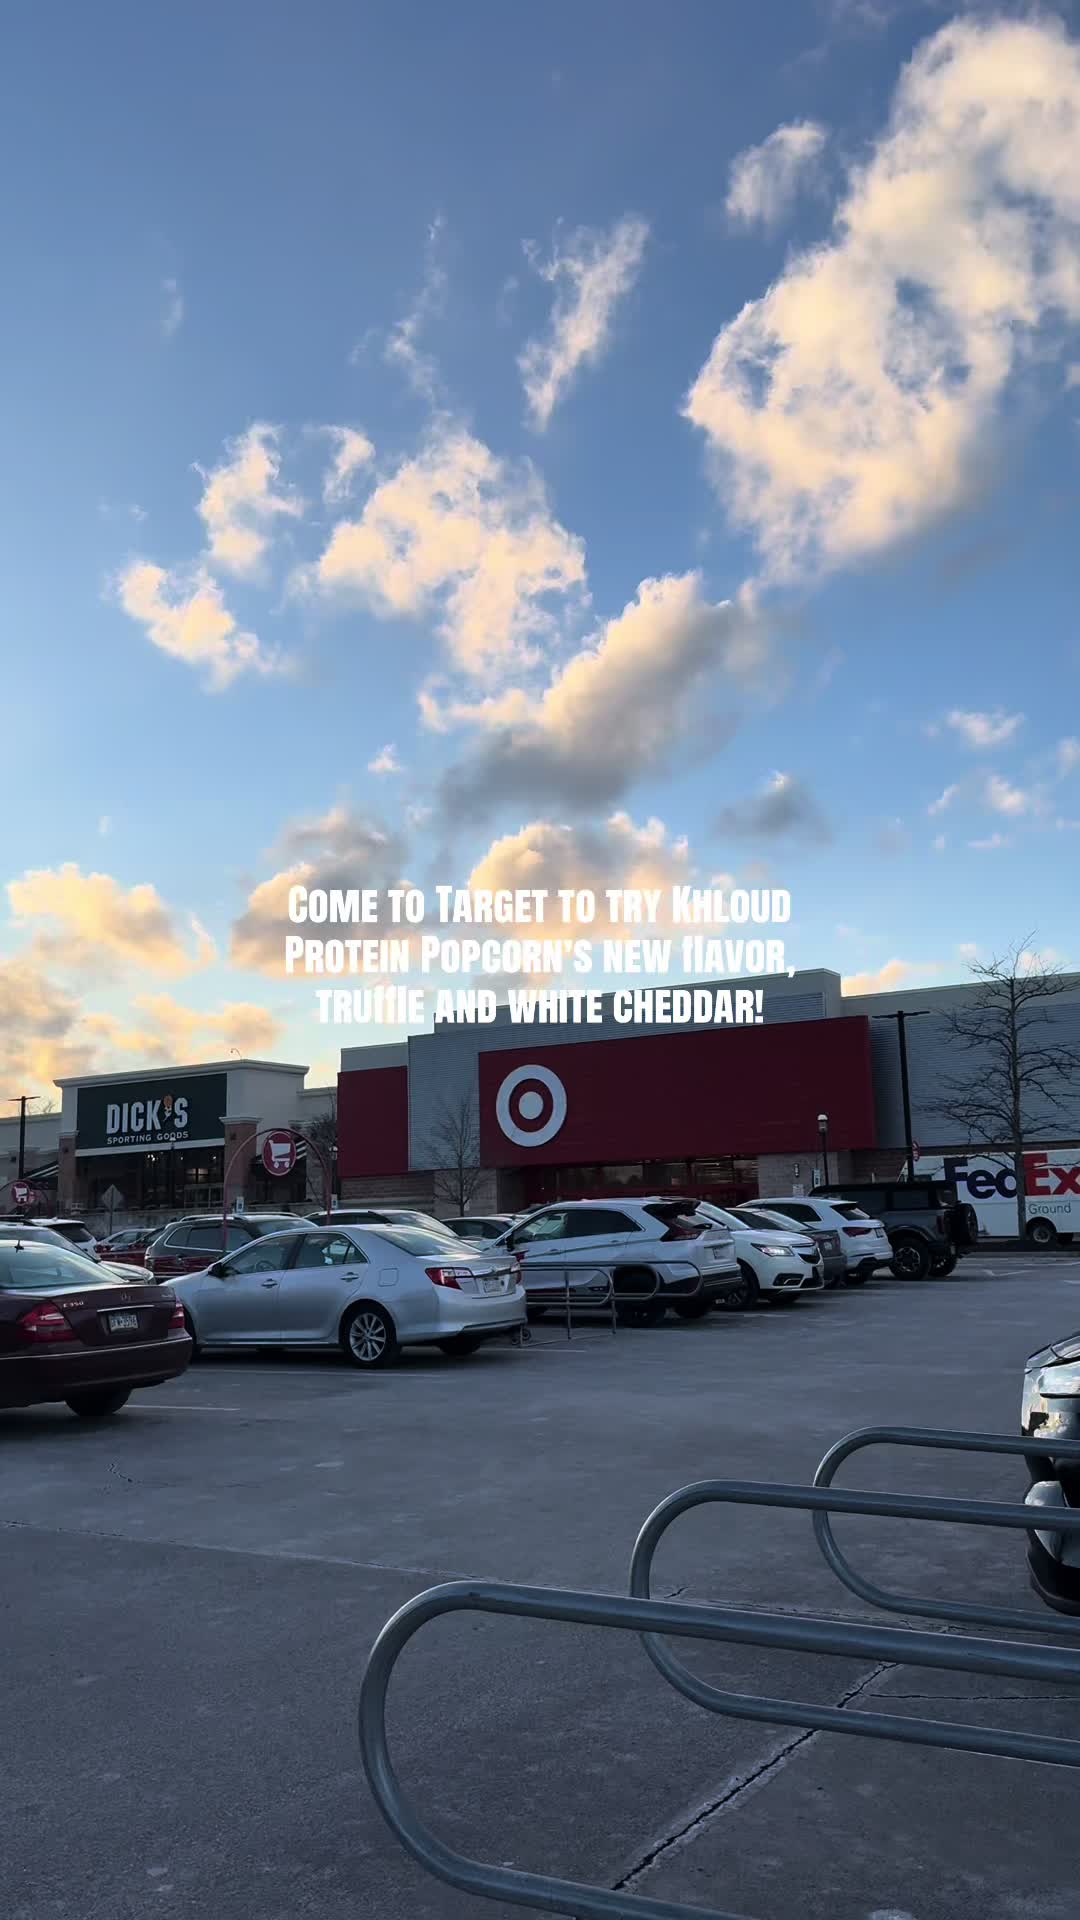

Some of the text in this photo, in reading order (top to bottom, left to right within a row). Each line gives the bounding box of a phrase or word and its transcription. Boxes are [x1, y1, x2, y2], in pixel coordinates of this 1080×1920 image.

[106, 1096, 189, 1134] DICK'S
[107, 1131, 189, 1145] SPORTING GOODS
[1028, 1202, 1072, 1215] Ground
